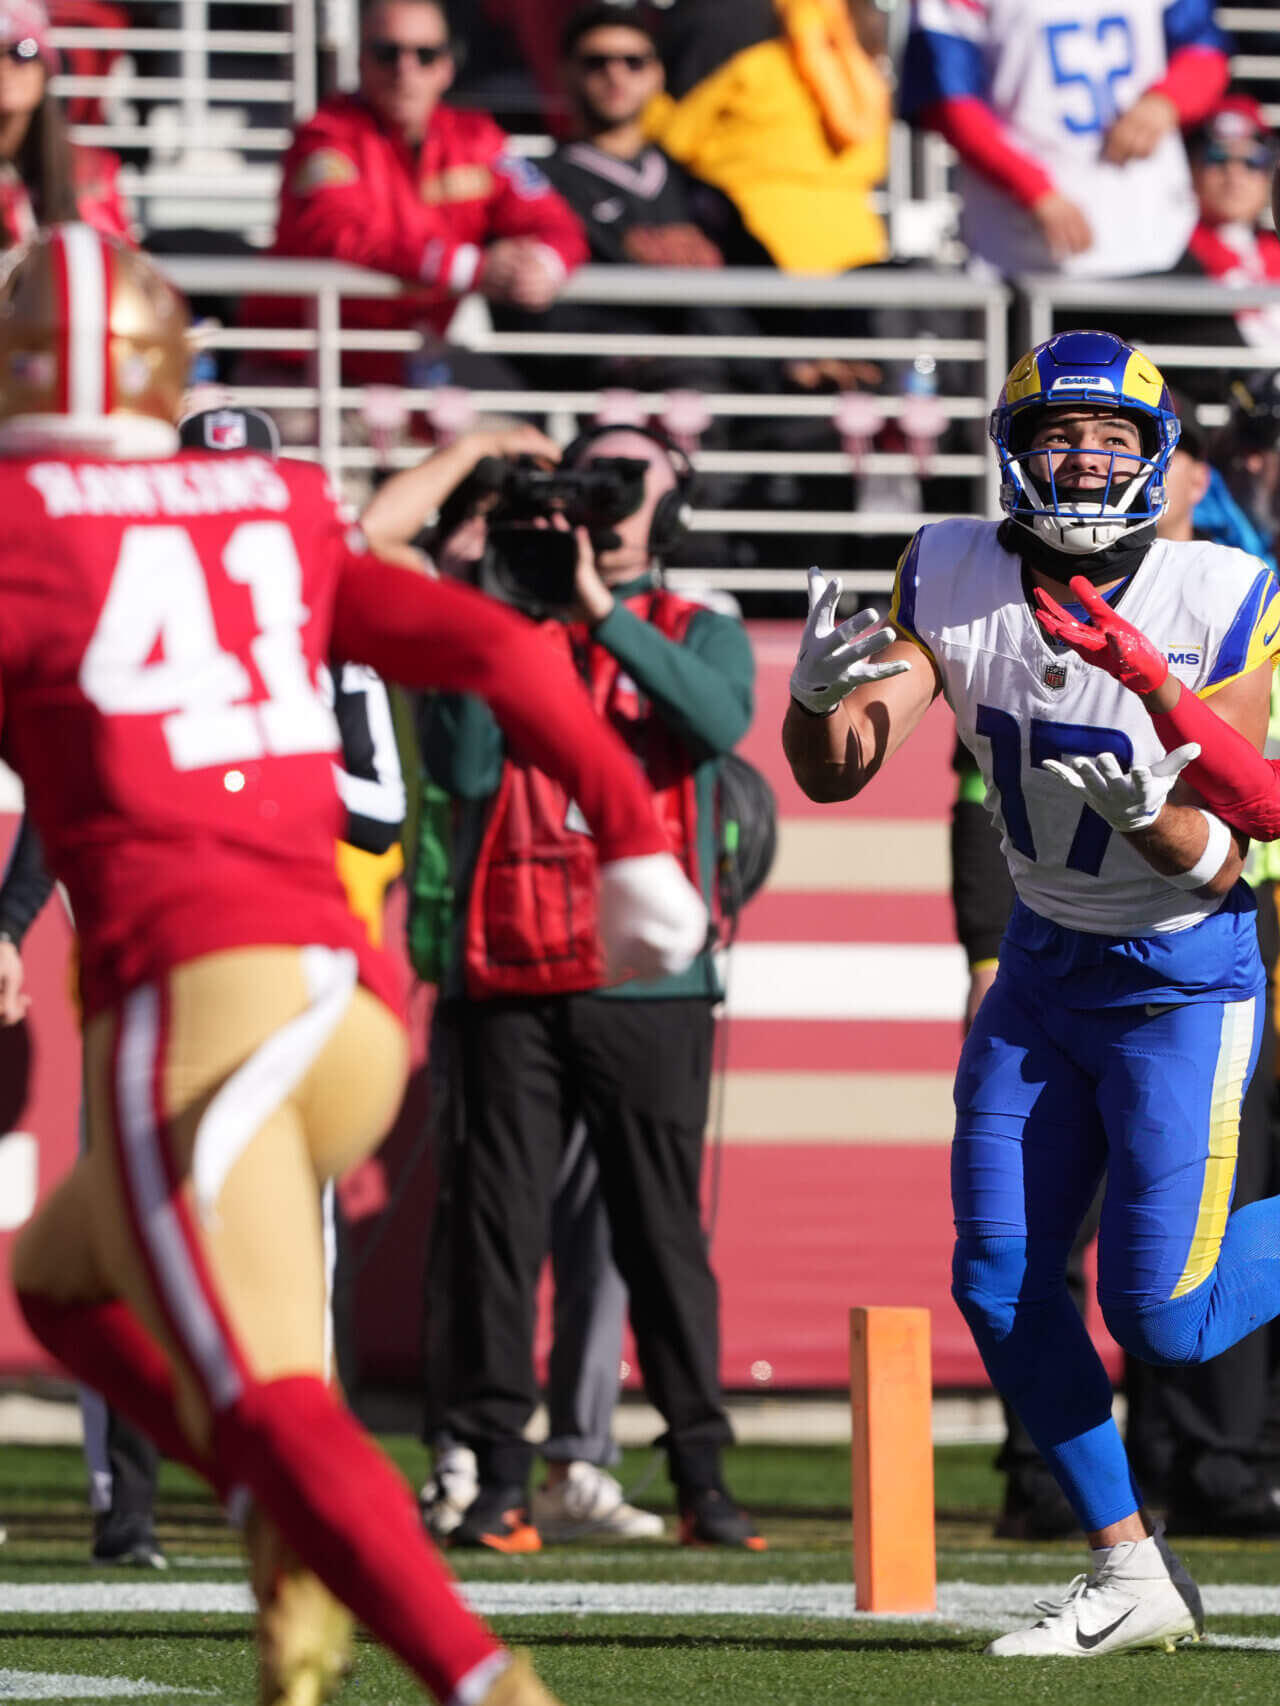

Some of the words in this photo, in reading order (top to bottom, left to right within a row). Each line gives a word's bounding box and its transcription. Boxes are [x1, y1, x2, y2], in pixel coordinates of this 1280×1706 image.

[1045, 17, 1132, 133] 52
[79, 521, 341, 771] 41
[1167, 652, 1200, 665] MS
[975, 703, 1134, 877] 17
